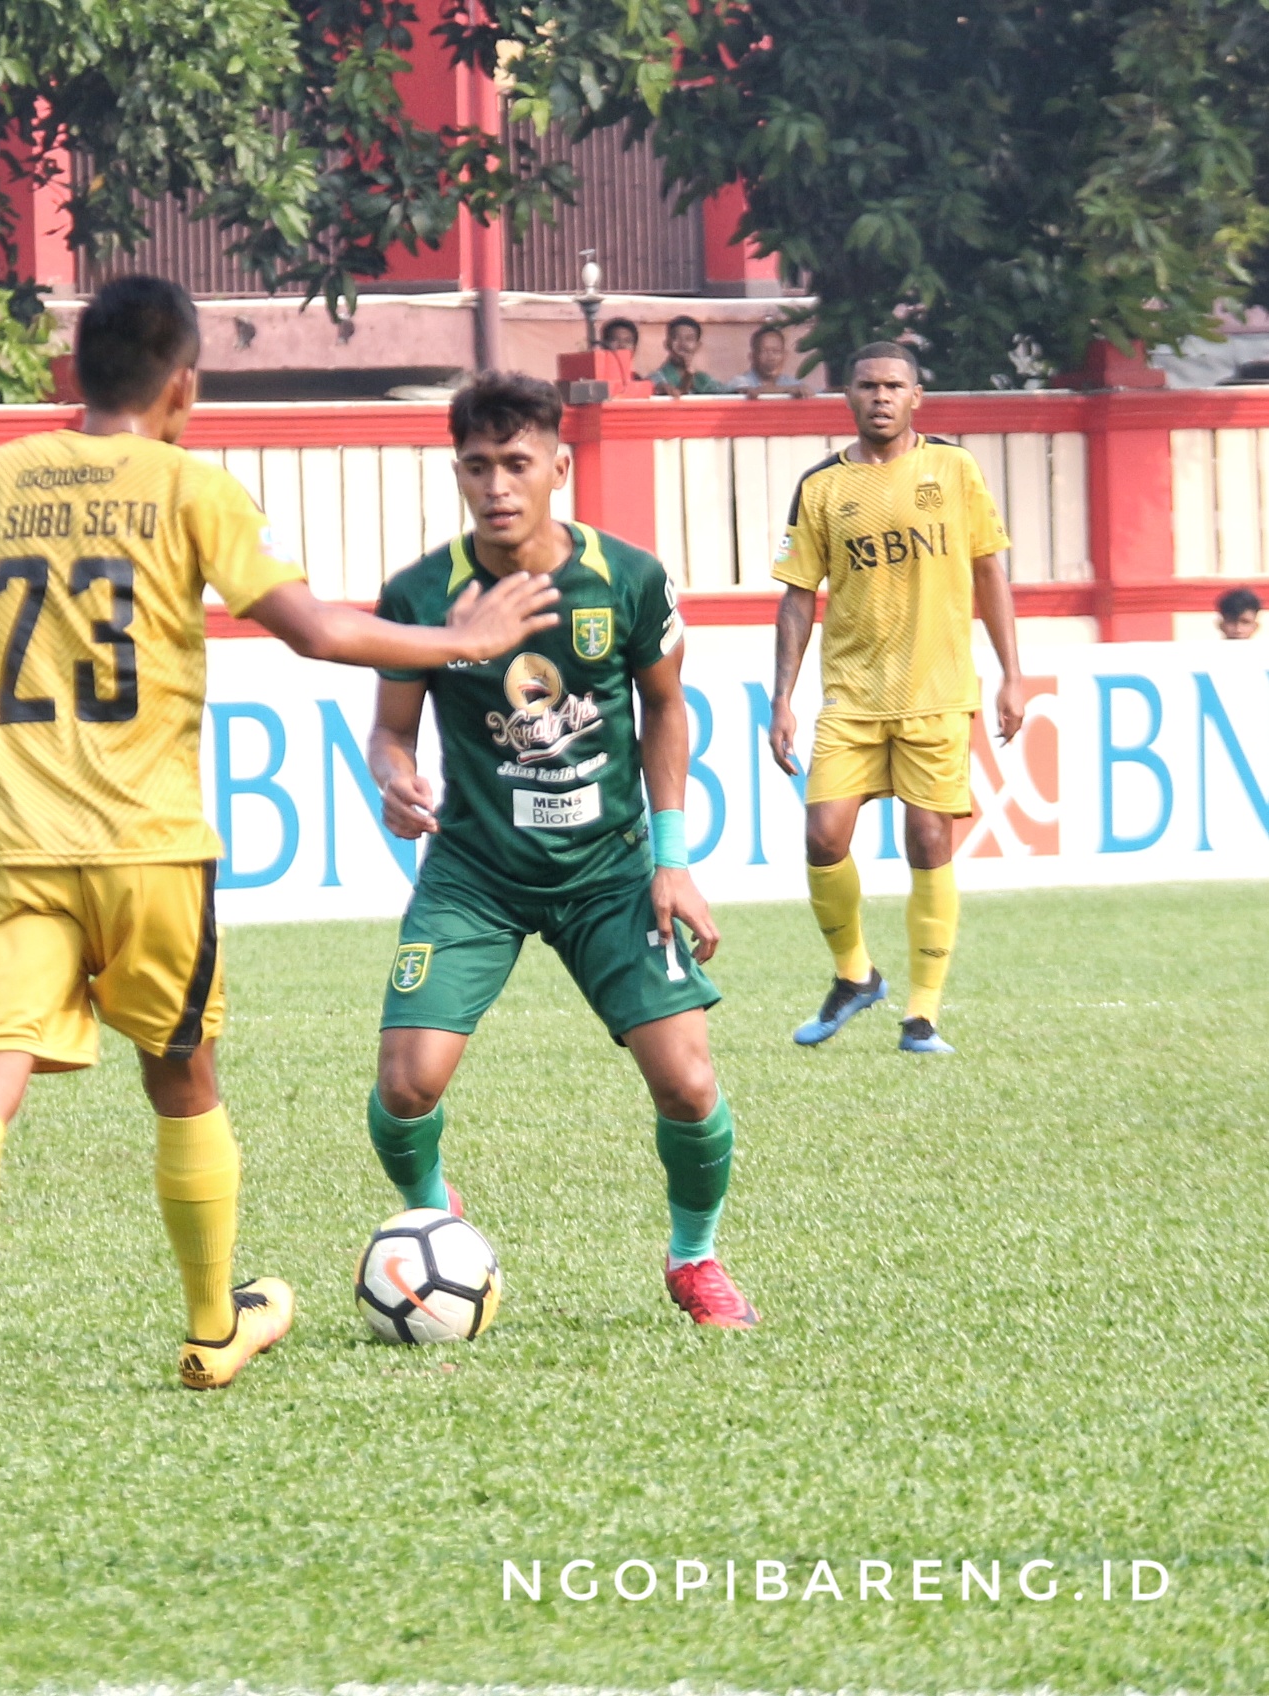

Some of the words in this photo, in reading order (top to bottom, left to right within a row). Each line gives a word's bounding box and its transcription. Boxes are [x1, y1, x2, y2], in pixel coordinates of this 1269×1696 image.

[3, 501, 72, 540] SUBO
[84, 499, 158, 540] SETO
[882, 522, 948, 565] BNI
